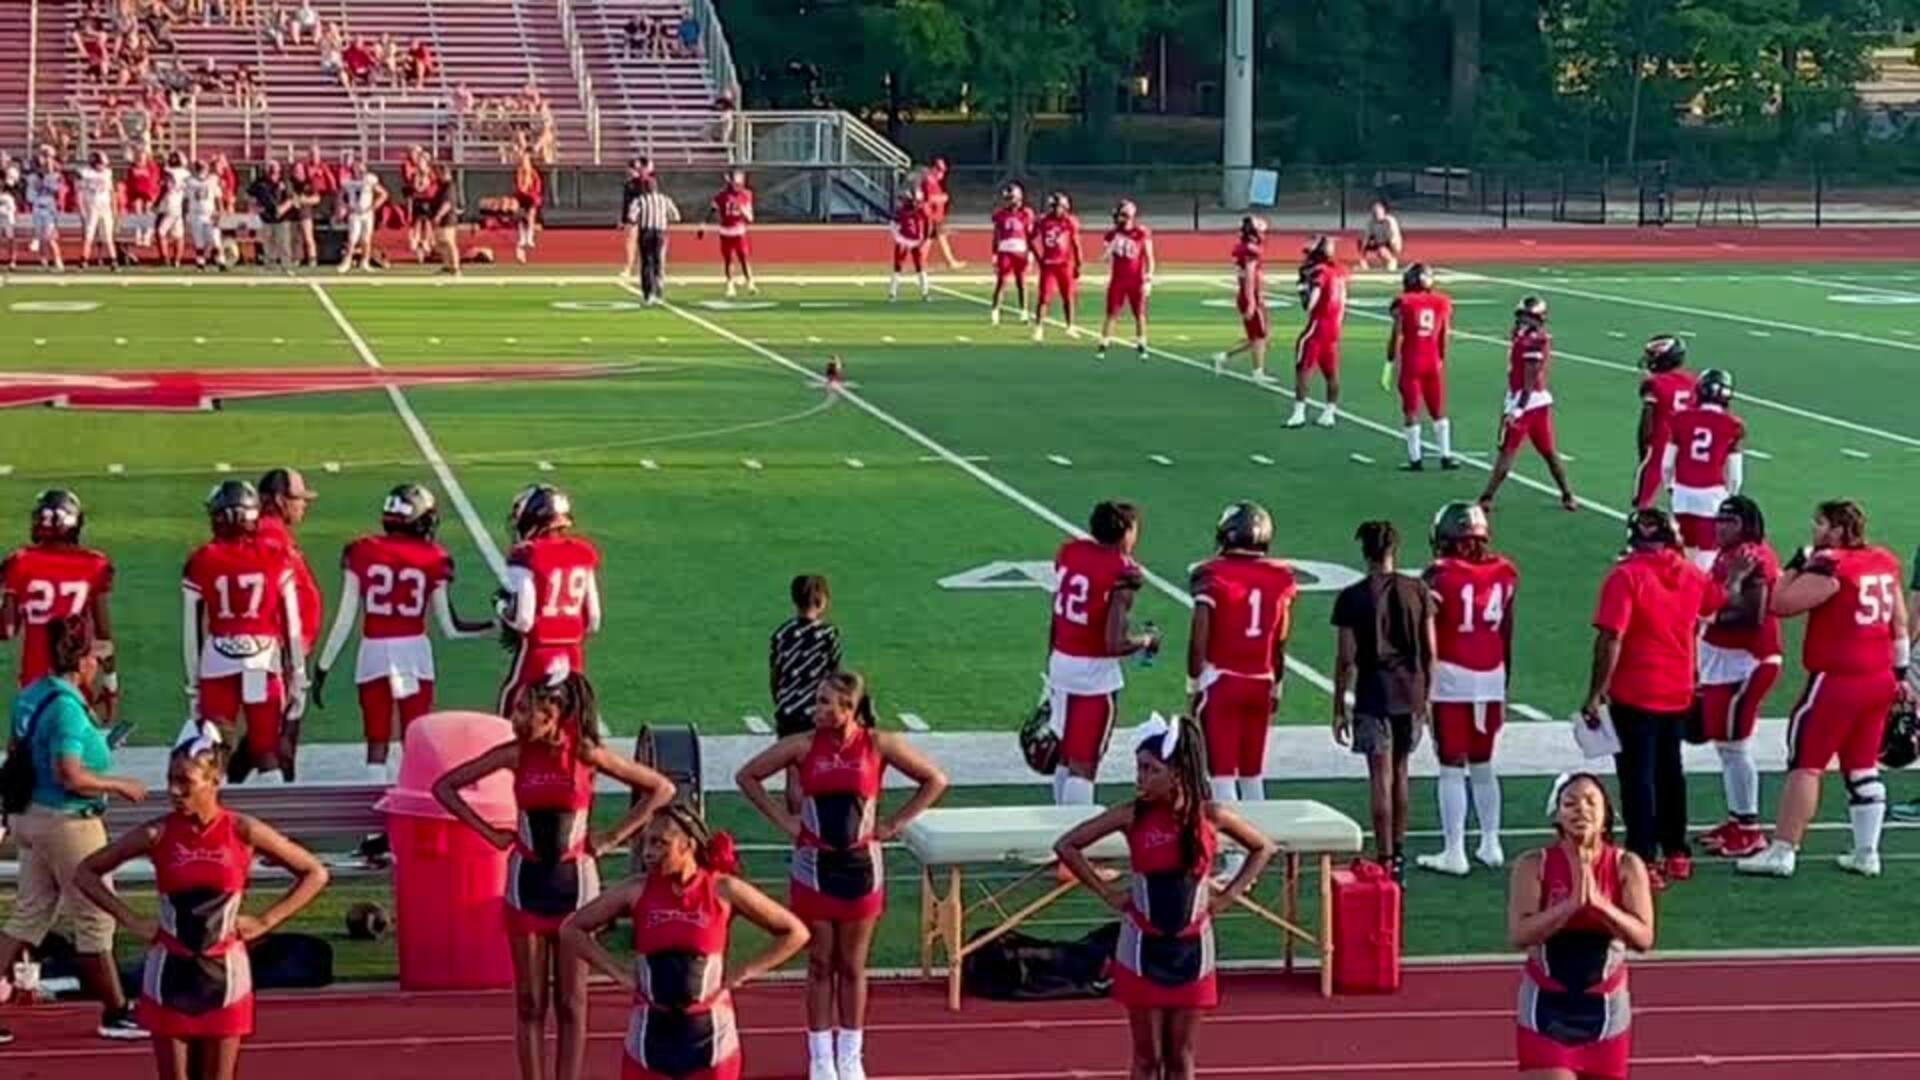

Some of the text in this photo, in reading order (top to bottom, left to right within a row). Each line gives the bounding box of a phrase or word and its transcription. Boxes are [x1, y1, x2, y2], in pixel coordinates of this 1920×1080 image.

[1417, 308, 1435, 337] 9
[1690, 426, 1714, 462] 2
[25, 579, 90, 624] 27
[215, 573, 265, 619] 17
[366, 564, 426, 617] 23
[541, 567, 588, 617] 19
[1245, 588, 1262, 638] 1
[1457, 583, 1504, 633] 14
[1854, 573, 1895, 625] 55
